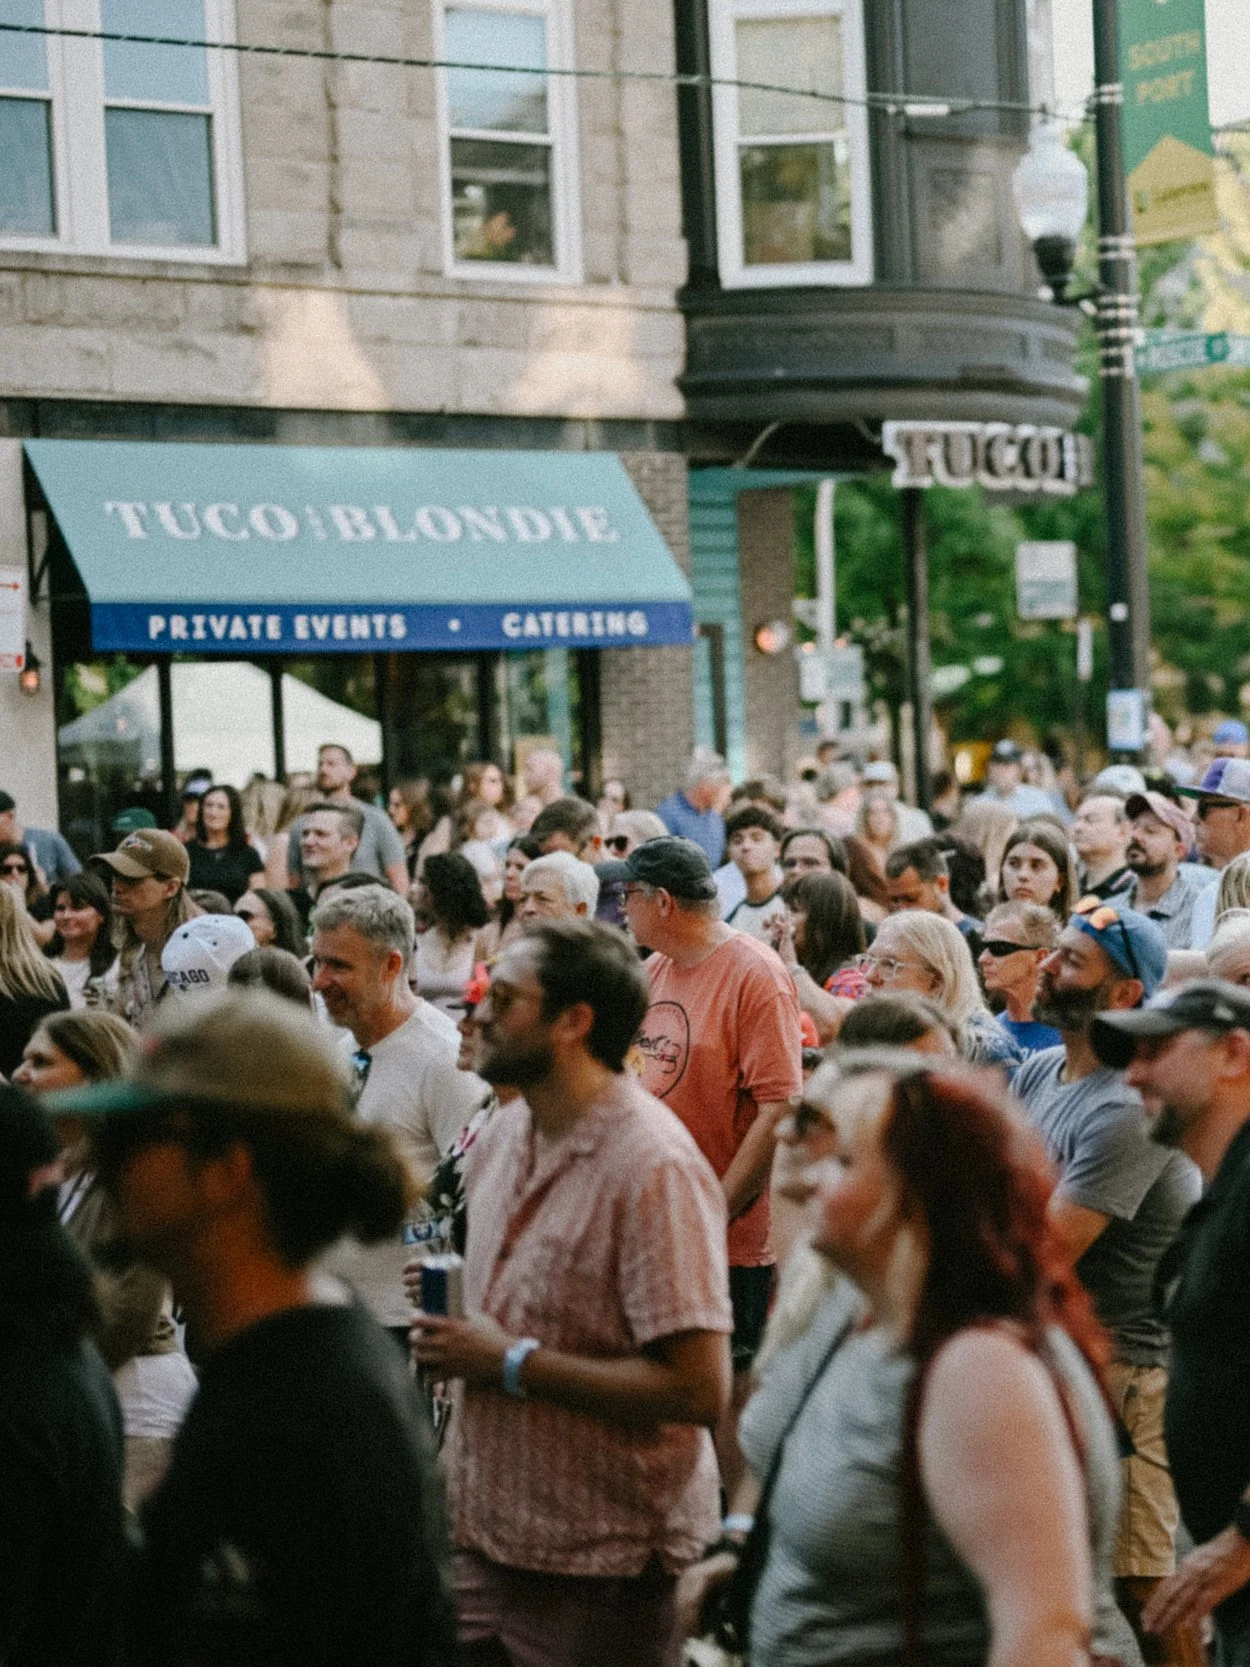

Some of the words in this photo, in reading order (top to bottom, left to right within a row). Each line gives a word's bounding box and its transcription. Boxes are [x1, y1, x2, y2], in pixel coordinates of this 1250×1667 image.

[1128, 29, 1201, 71] SOUTH
[1136, 70, 1196, 104] PORT
[104, 501, 299, 542] TUCO
[330, 503, 620, 544] BLONDIE
[148, 614, 282, 641] PRIVATE
[294, 613, 408, 640] EVENTS
[502, 609, 648, 638] CATERING
